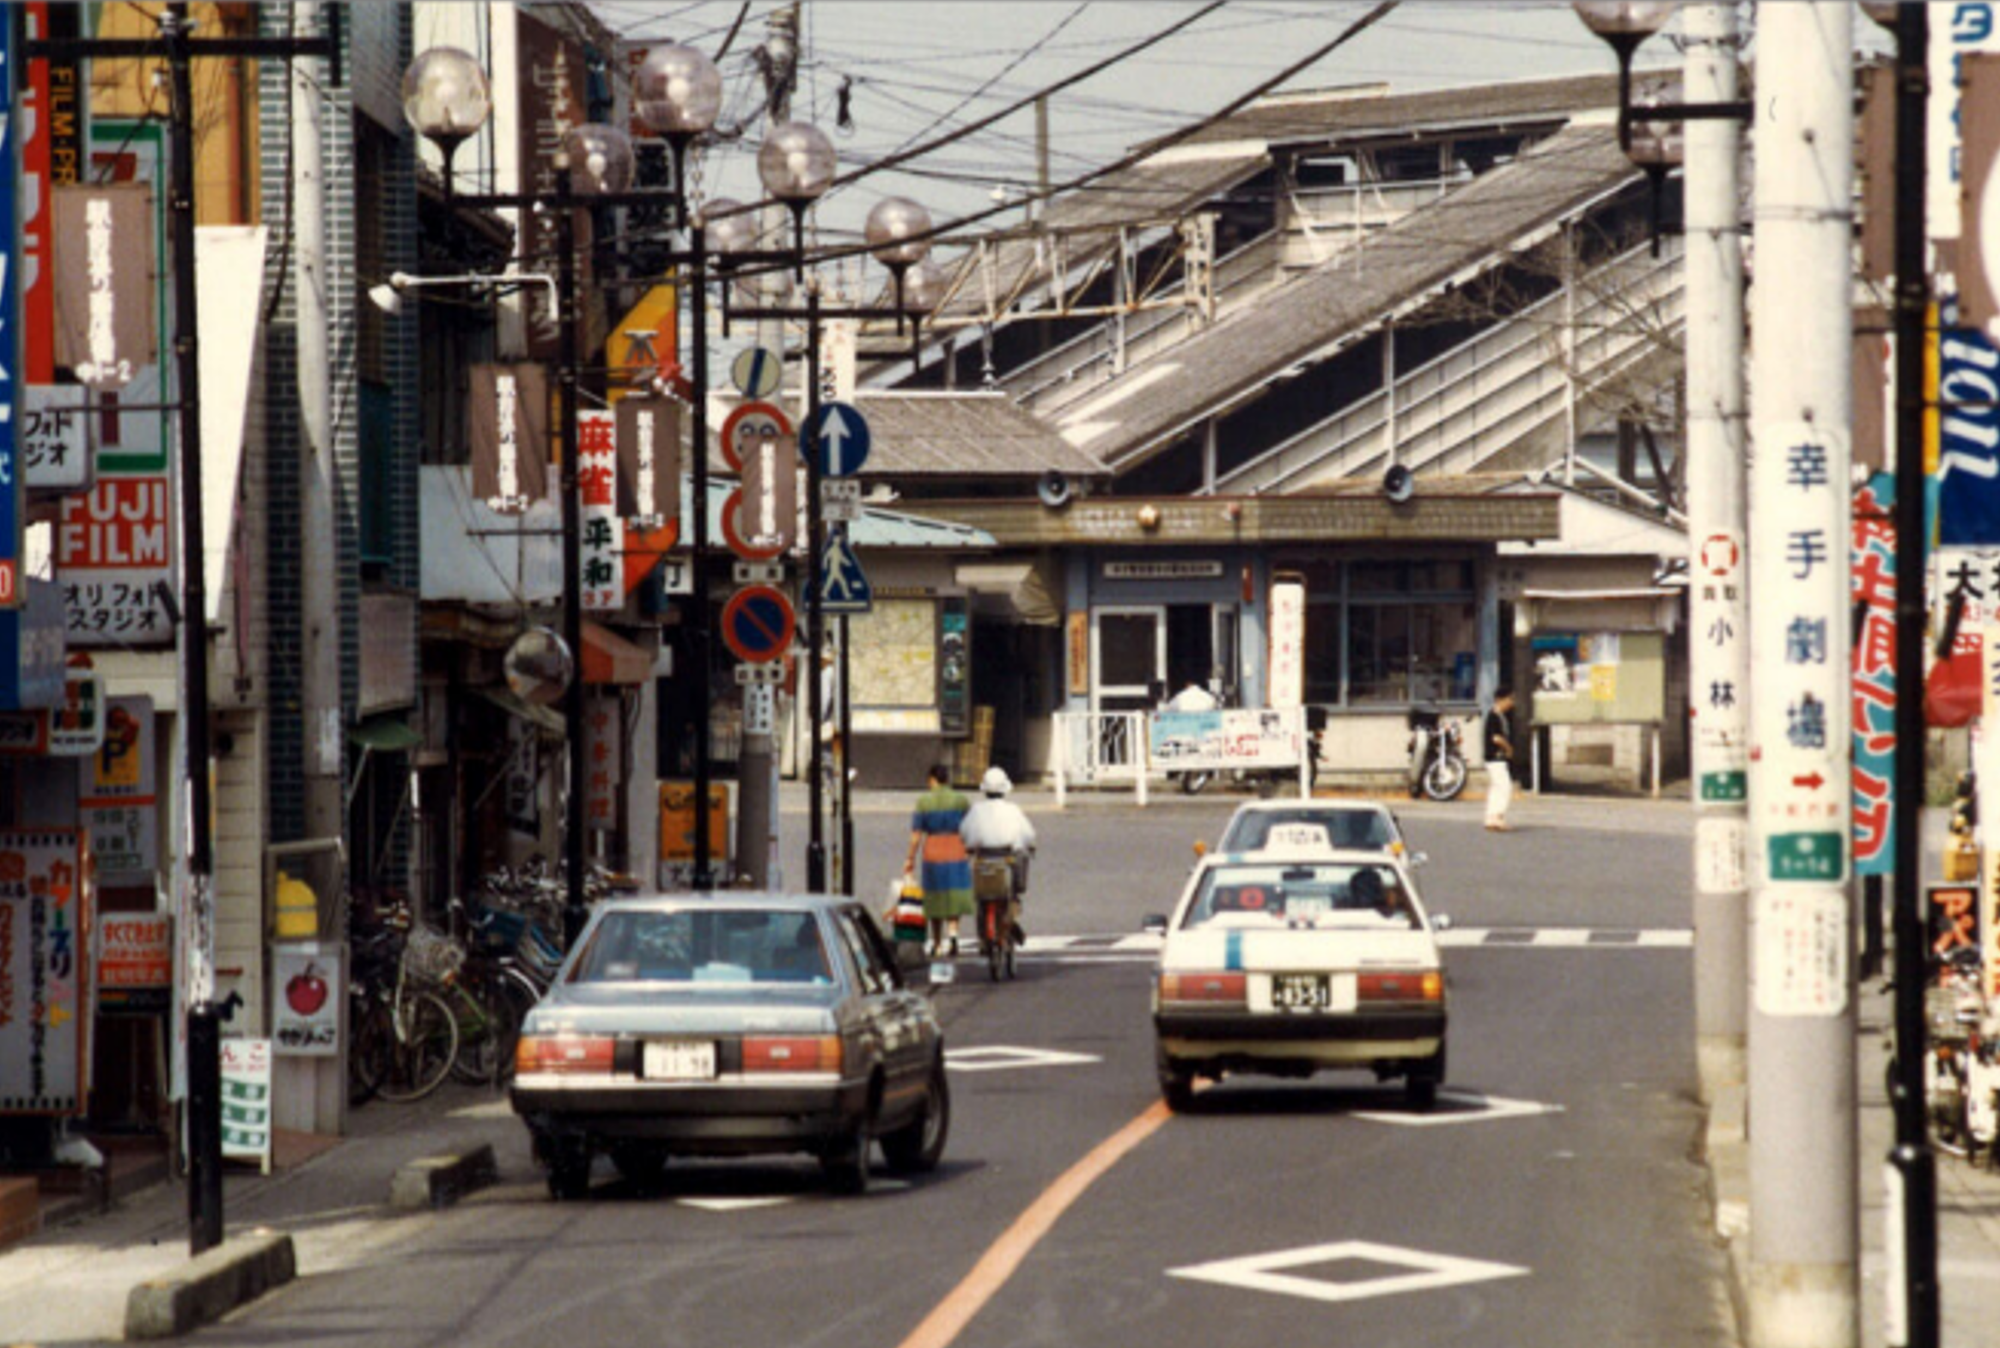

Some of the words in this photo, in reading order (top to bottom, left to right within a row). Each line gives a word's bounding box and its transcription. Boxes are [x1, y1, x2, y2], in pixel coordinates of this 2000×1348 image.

[578, 416, 614, 506] 麻雀
[61, 483, 166, 522] FUJI
[60, 524, 166, 563] FILM
[583, 516, 614, 587] 平和
[68, 608, 158, 631] スタジオ
